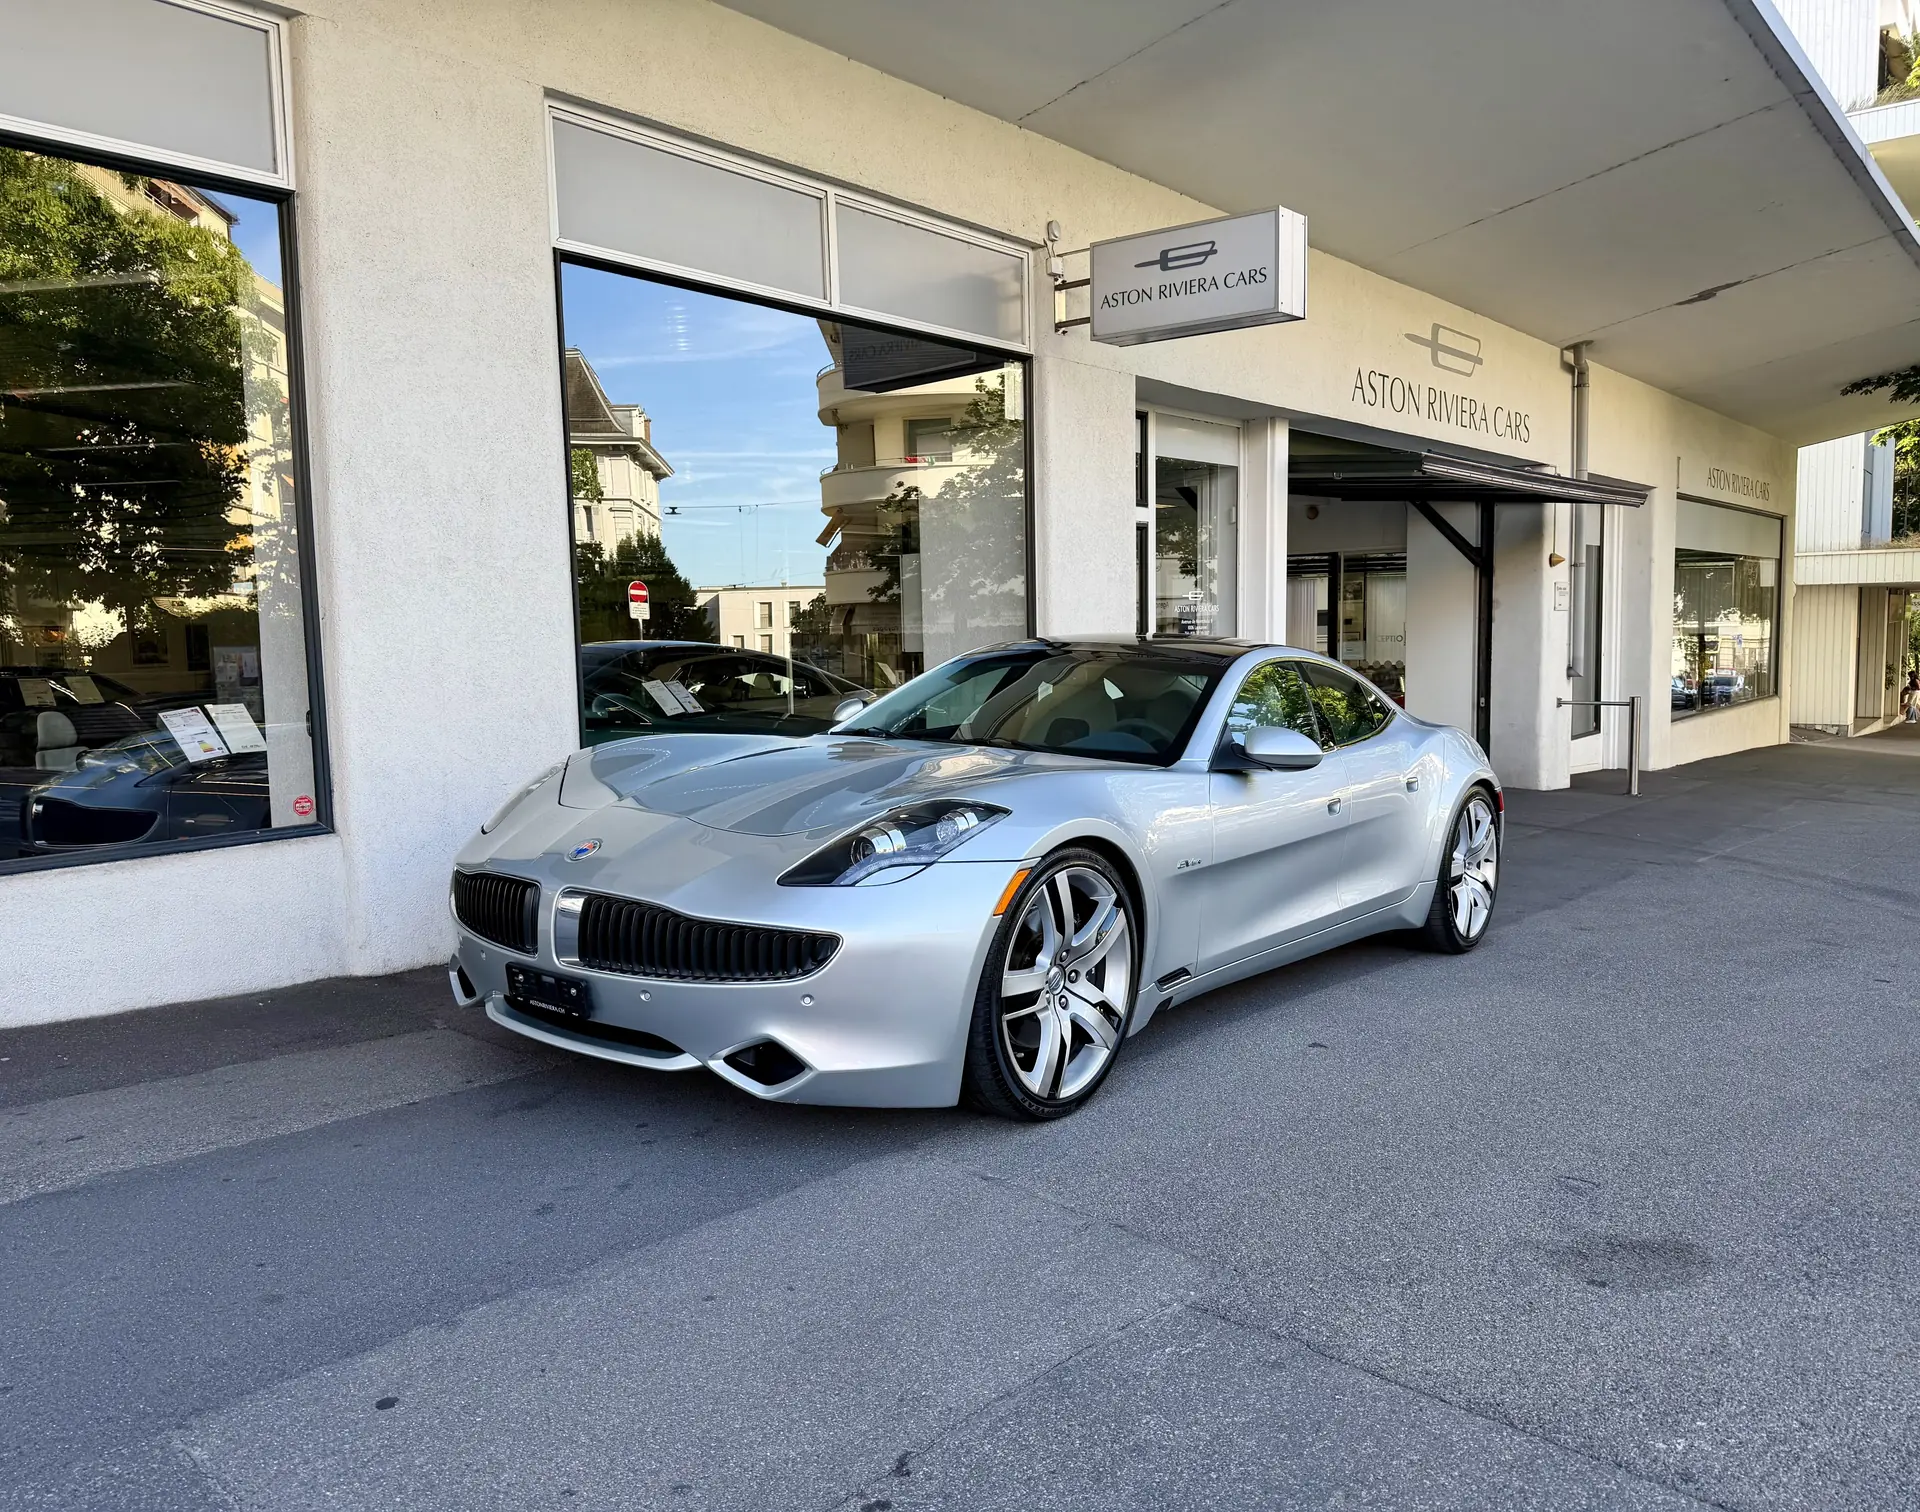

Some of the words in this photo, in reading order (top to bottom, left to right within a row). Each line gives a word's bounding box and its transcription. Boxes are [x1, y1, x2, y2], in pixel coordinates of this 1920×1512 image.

[1100, 287, 1152, 309] ASTON
[1158, 276, 1219, 300] RIVIERA
[1223, 267, 1267, 289] CARS
[1351, 366, 1421, 417] ASTON
[1427, 387, 1489, 434] RIVIERA
[1493, 406, 1530, 443] CARS
[1706, 467, 1731, 492] ASTON
[1731, 473, 1754, 497] RIVIERA
[1755, 480, 1770, 501] CARS
[1174, 605, 1190, 613] ASTON
[1207, 604, 1219, 613] CARS
